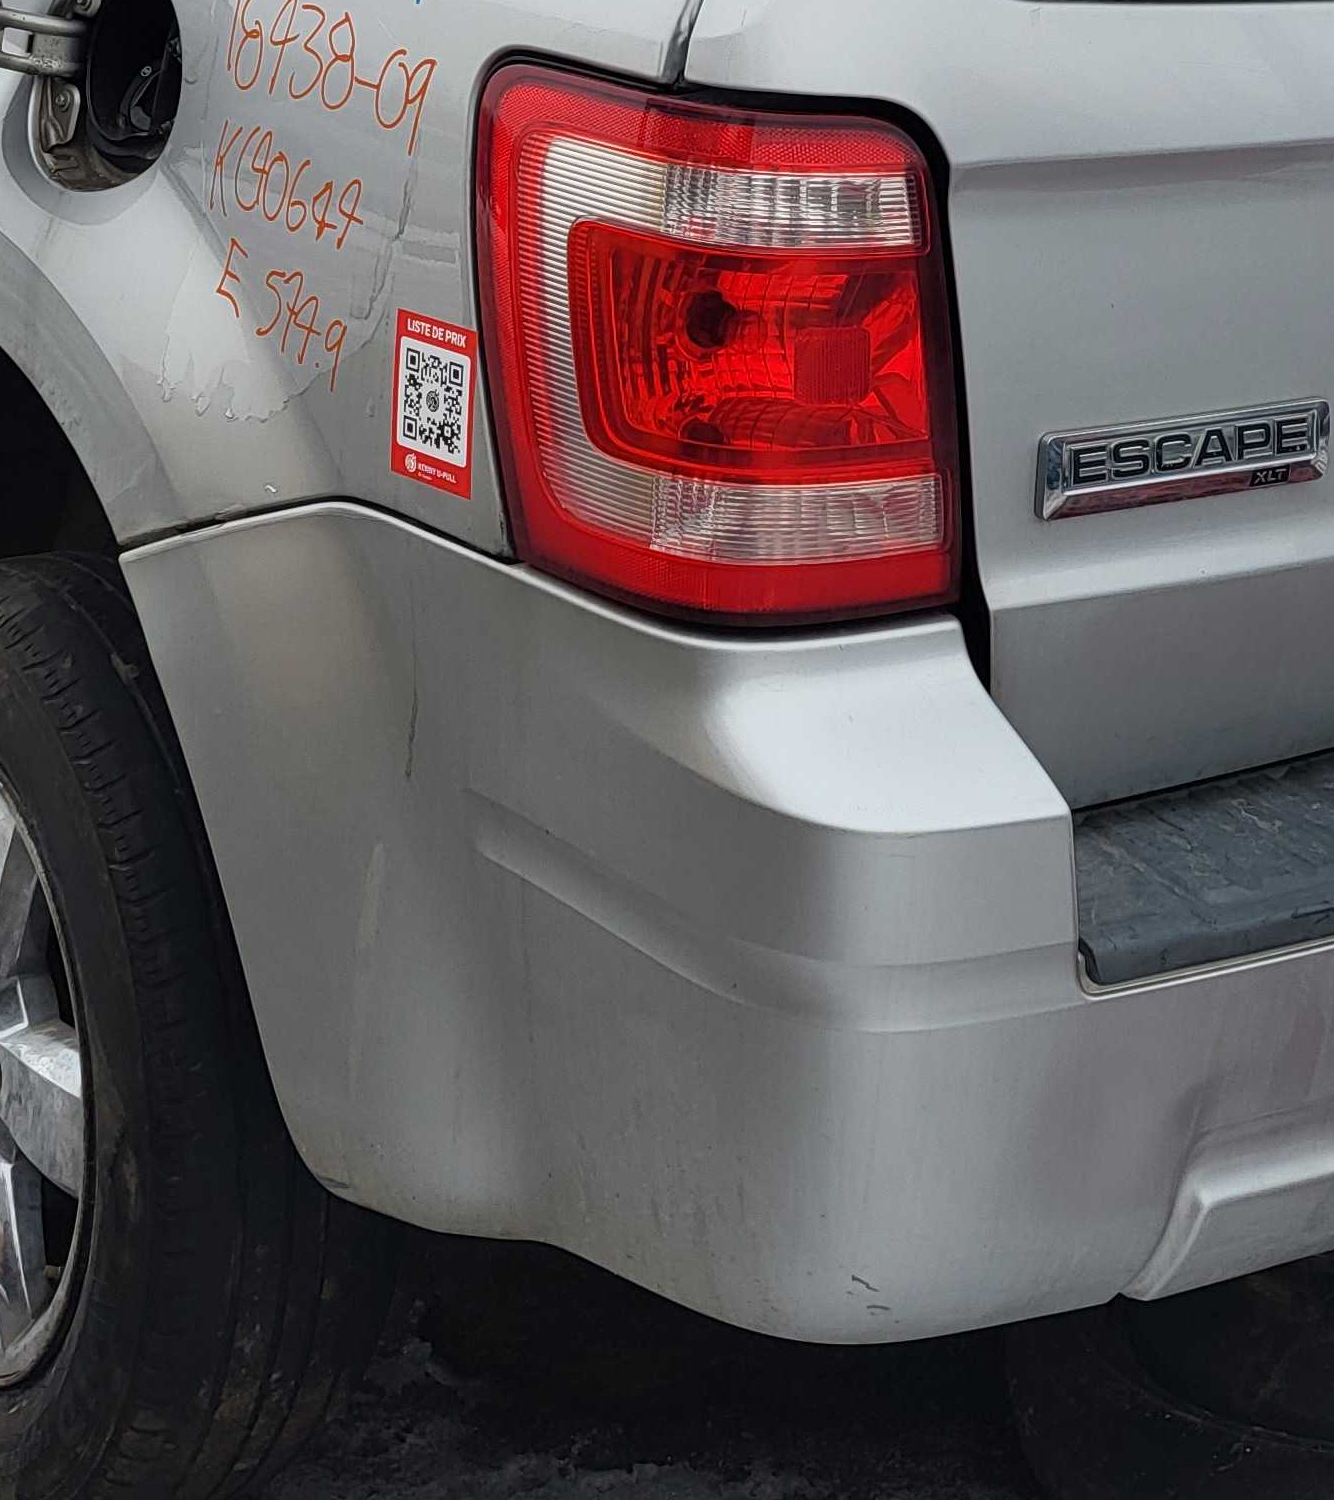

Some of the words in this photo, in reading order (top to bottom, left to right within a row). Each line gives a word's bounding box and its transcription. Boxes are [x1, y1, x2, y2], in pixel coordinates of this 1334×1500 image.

[407, 317, 431, 338] LISTE
[431, 325, 445, 341] DE
[444, 329, 467, 349] PRIX
[1069, 412, 1311, 487] ESCAPE
[1253, 467, 1289, 485] XLT
